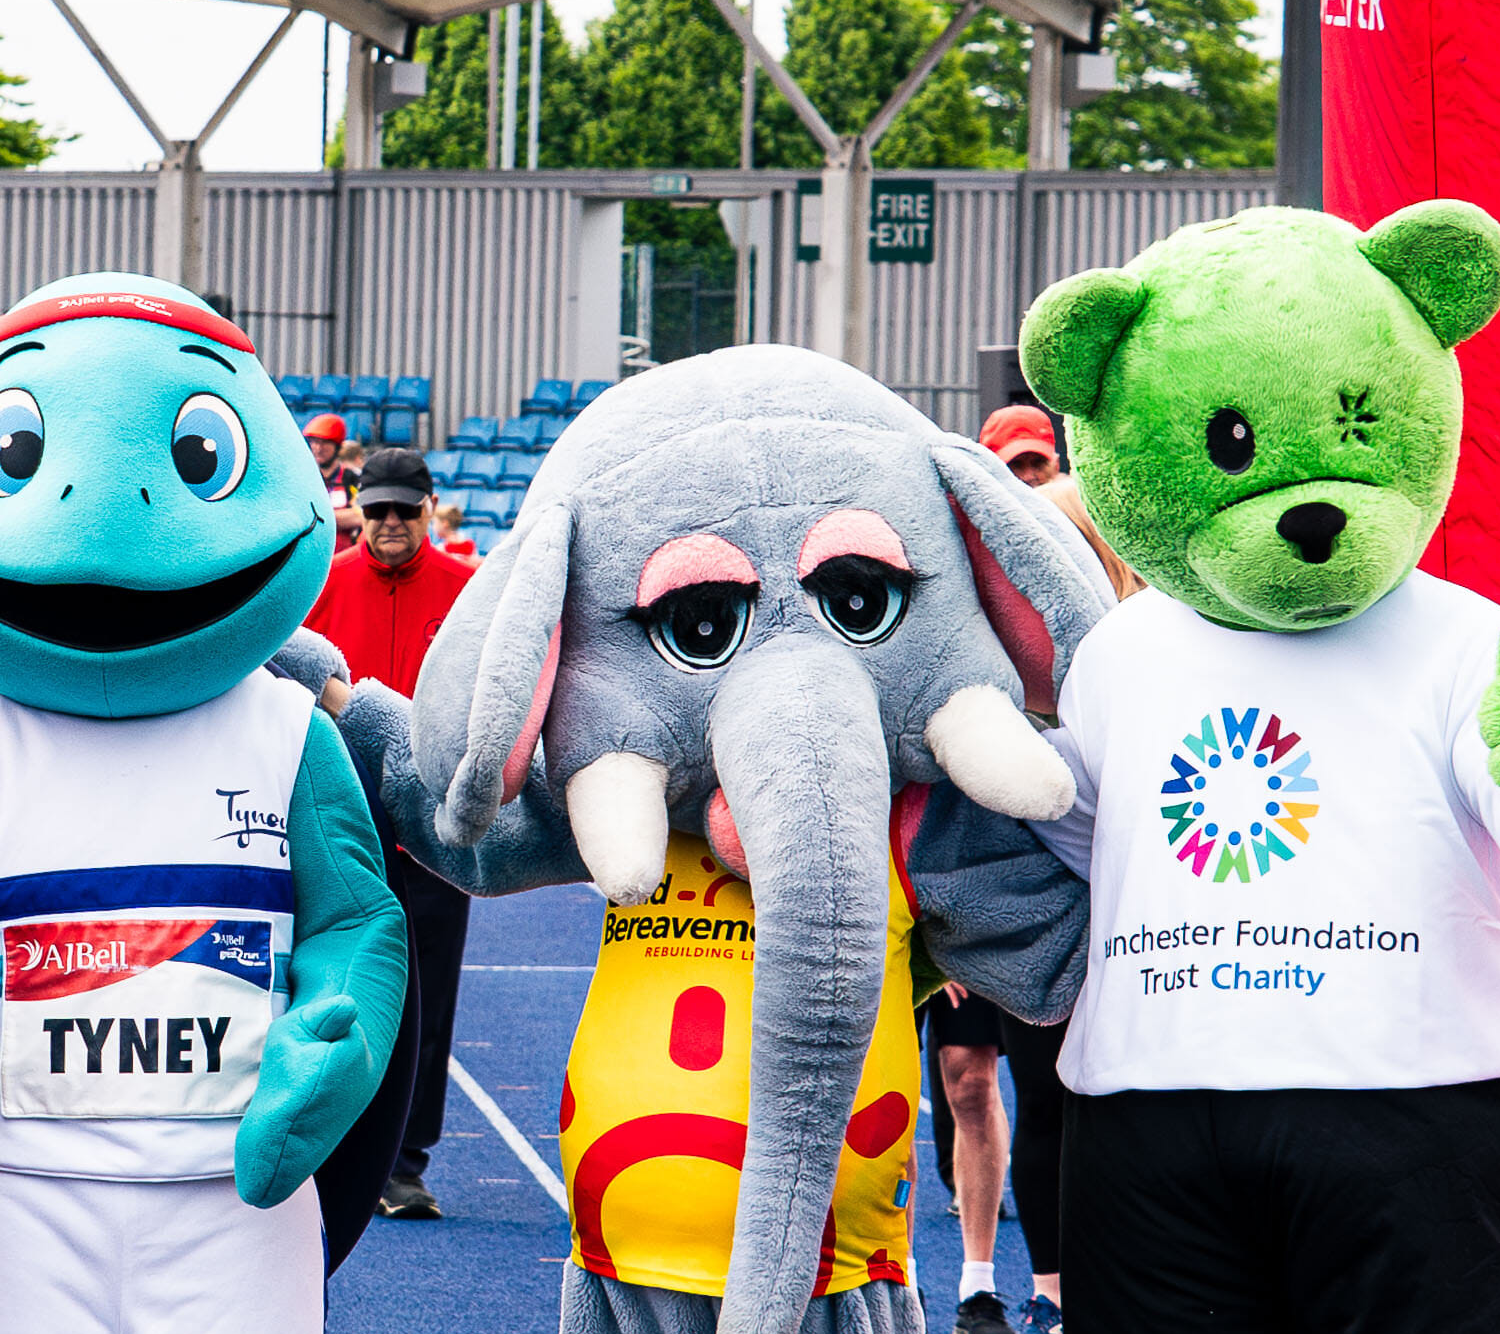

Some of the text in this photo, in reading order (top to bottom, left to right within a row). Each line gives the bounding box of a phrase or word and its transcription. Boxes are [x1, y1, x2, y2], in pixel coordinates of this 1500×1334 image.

[877, 194, 930, 219] FIRE
[877, 223, 929, 248] EXIT
[644, 946, 734, 959] REBUILDING
[1236, 920, 1420, 953] Foundation
[44, 941, 128, 975] AJBell
[1140, 961, 1326, 996] Trust Charity
[42, 1016, 232, 1074] TYNEY
